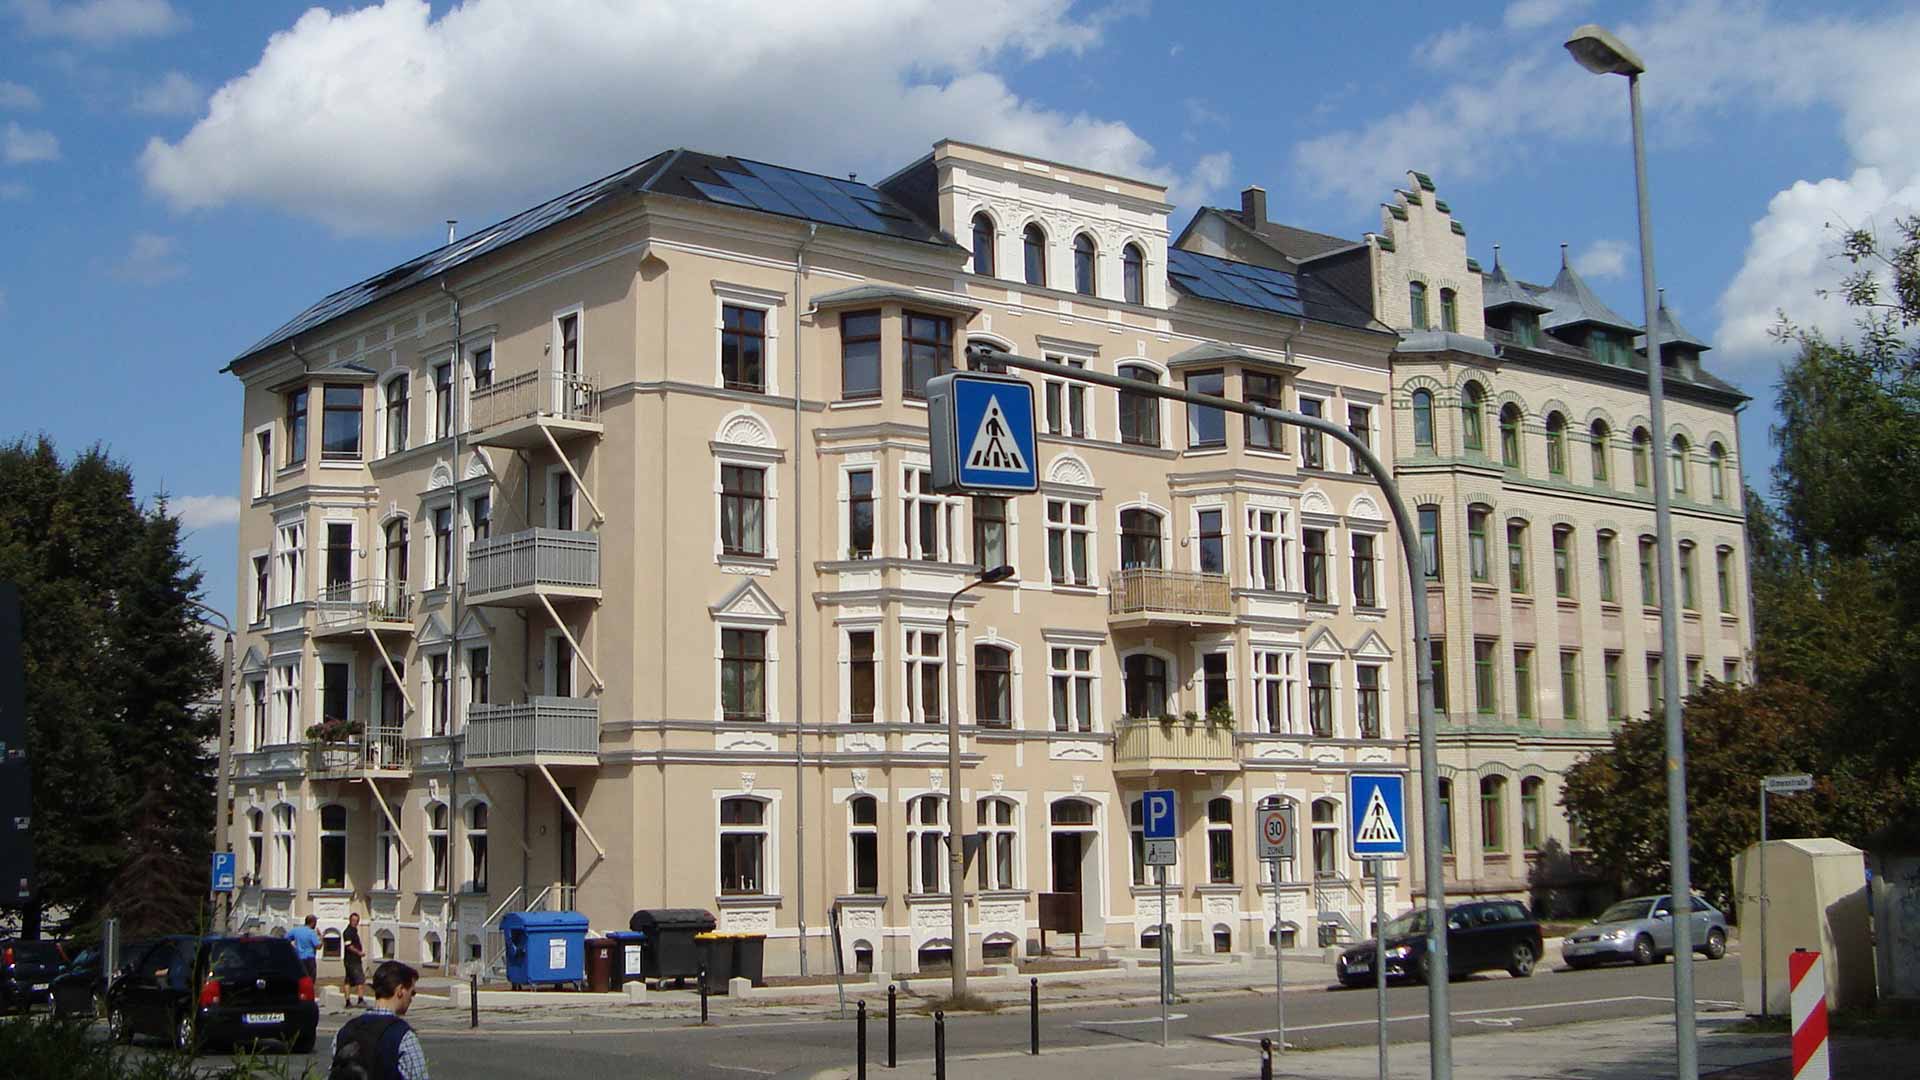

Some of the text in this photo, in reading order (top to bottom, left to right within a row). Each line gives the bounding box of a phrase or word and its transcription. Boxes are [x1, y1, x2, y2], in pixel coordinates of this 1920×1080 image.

[1150, 796, 1167, 832] P
[1269, 821, 1282, 836] 30
[1267, 846, 1284, 855] ZONE
[216, 855, 227, 870] P
